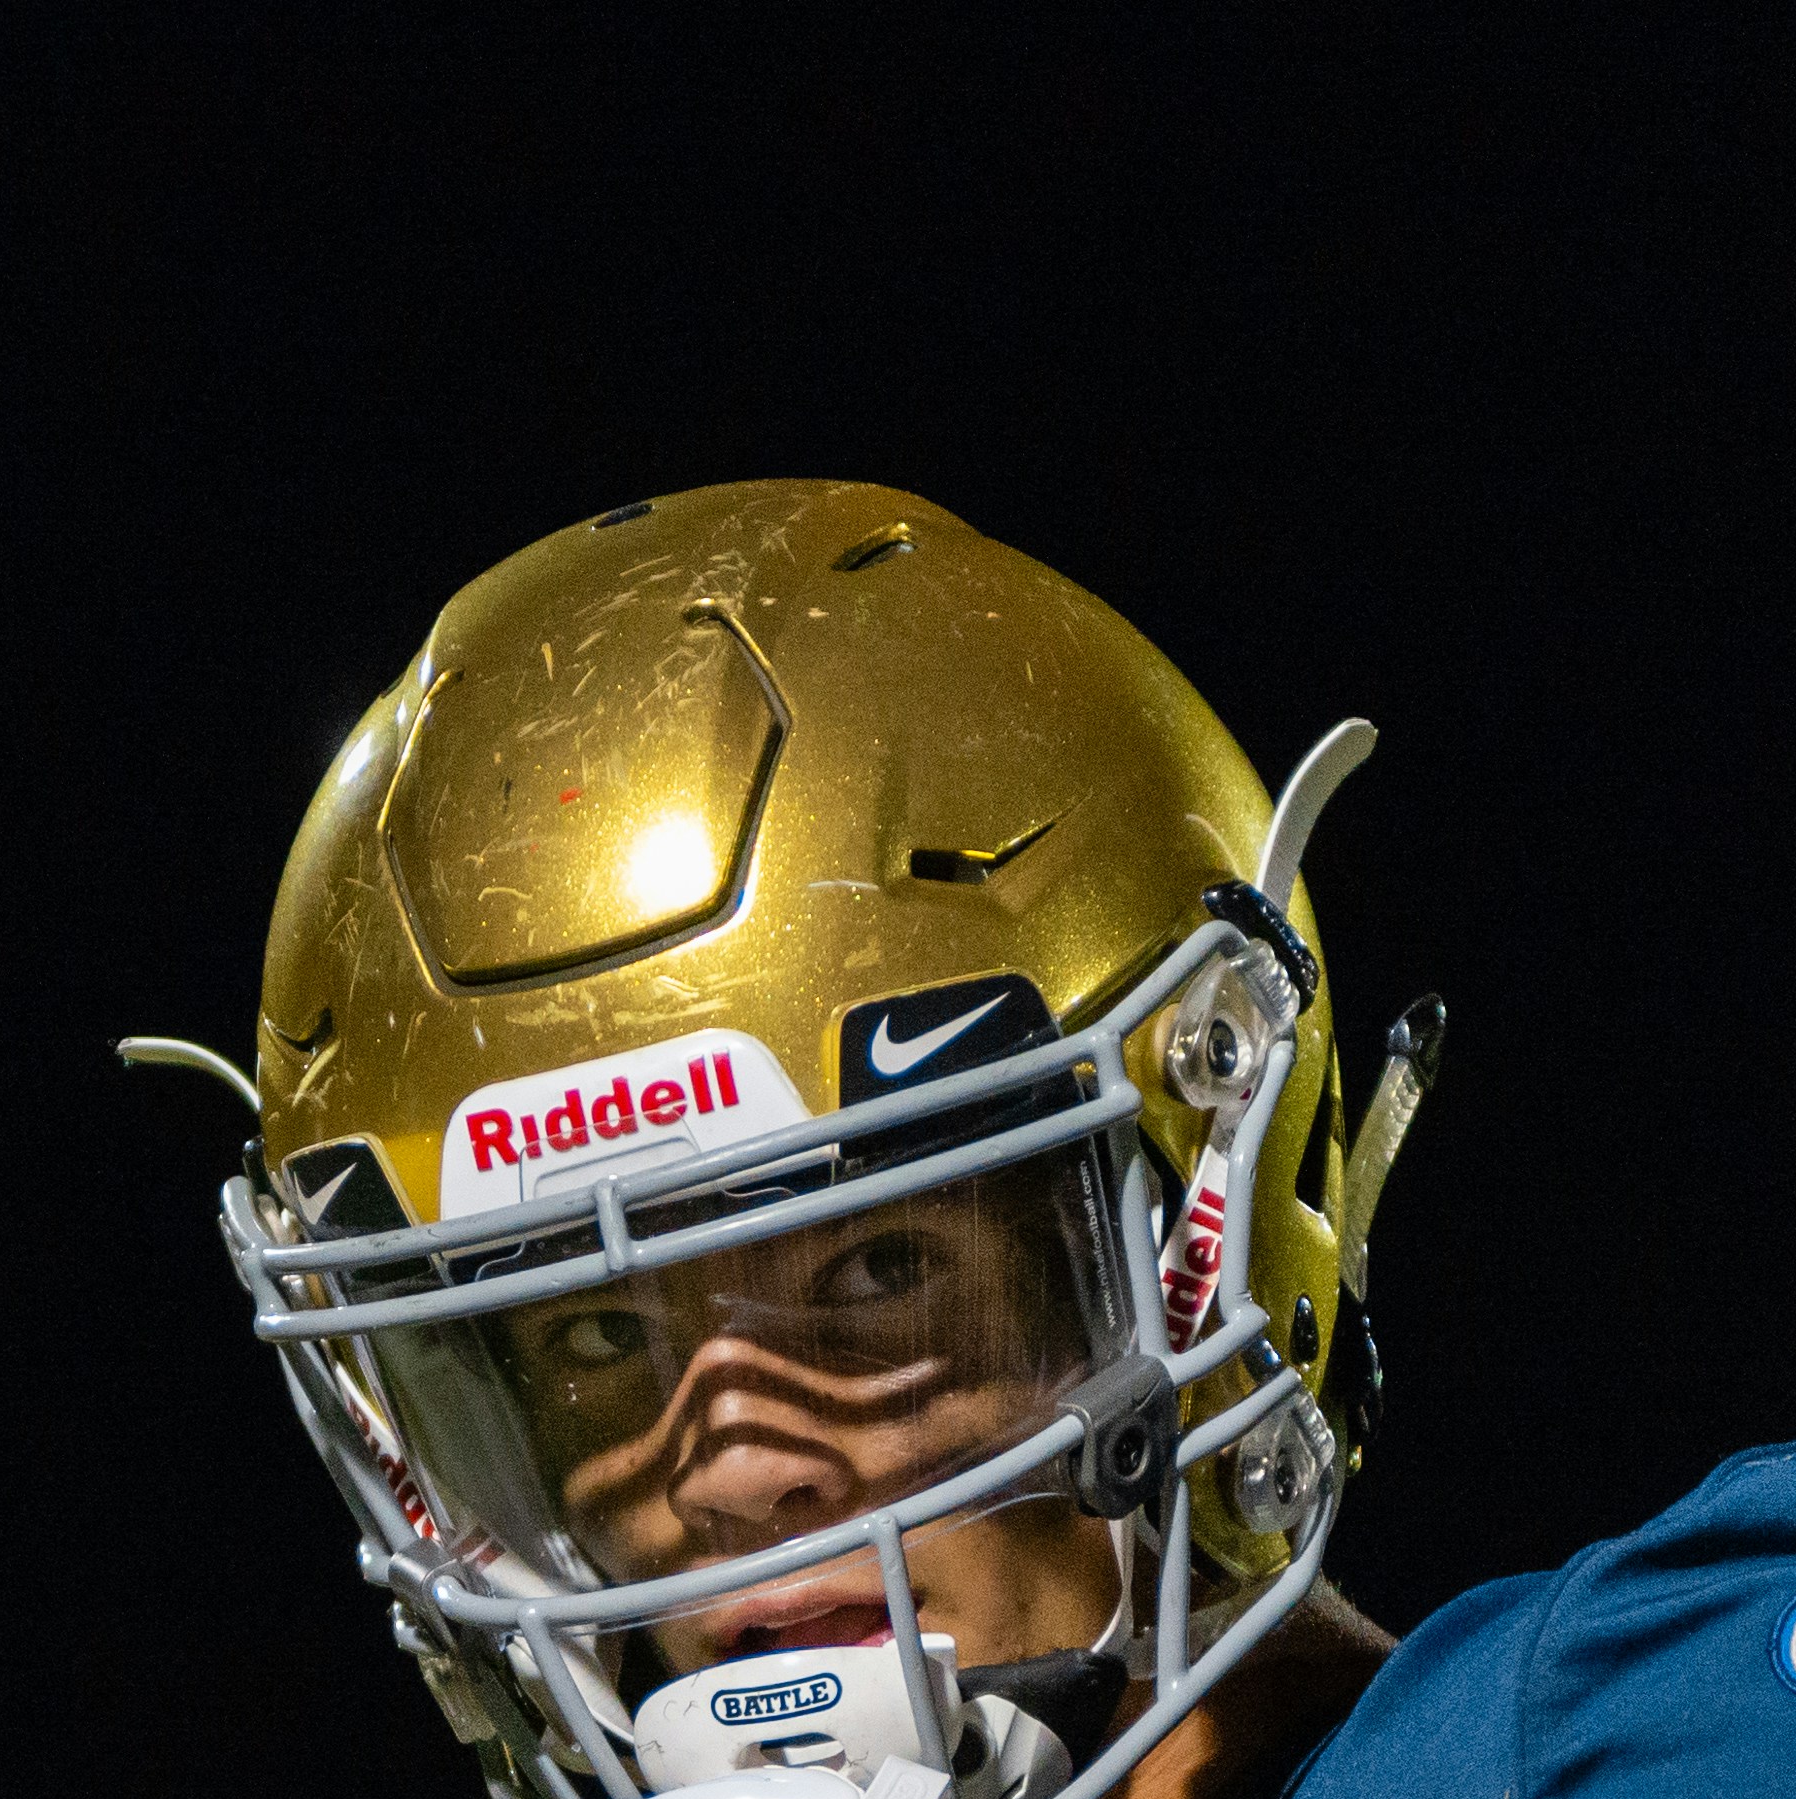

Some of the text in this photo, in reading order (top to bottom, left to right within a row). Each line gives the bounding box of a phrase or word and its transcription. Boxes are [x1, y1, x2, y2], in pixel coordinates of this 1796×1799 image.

[465, 1049, 740, 1171] Riddell
[1079, 1160, 1117, 1329] www.nikefootball.com
[722, 1680, 830, 1718] BATTLE
